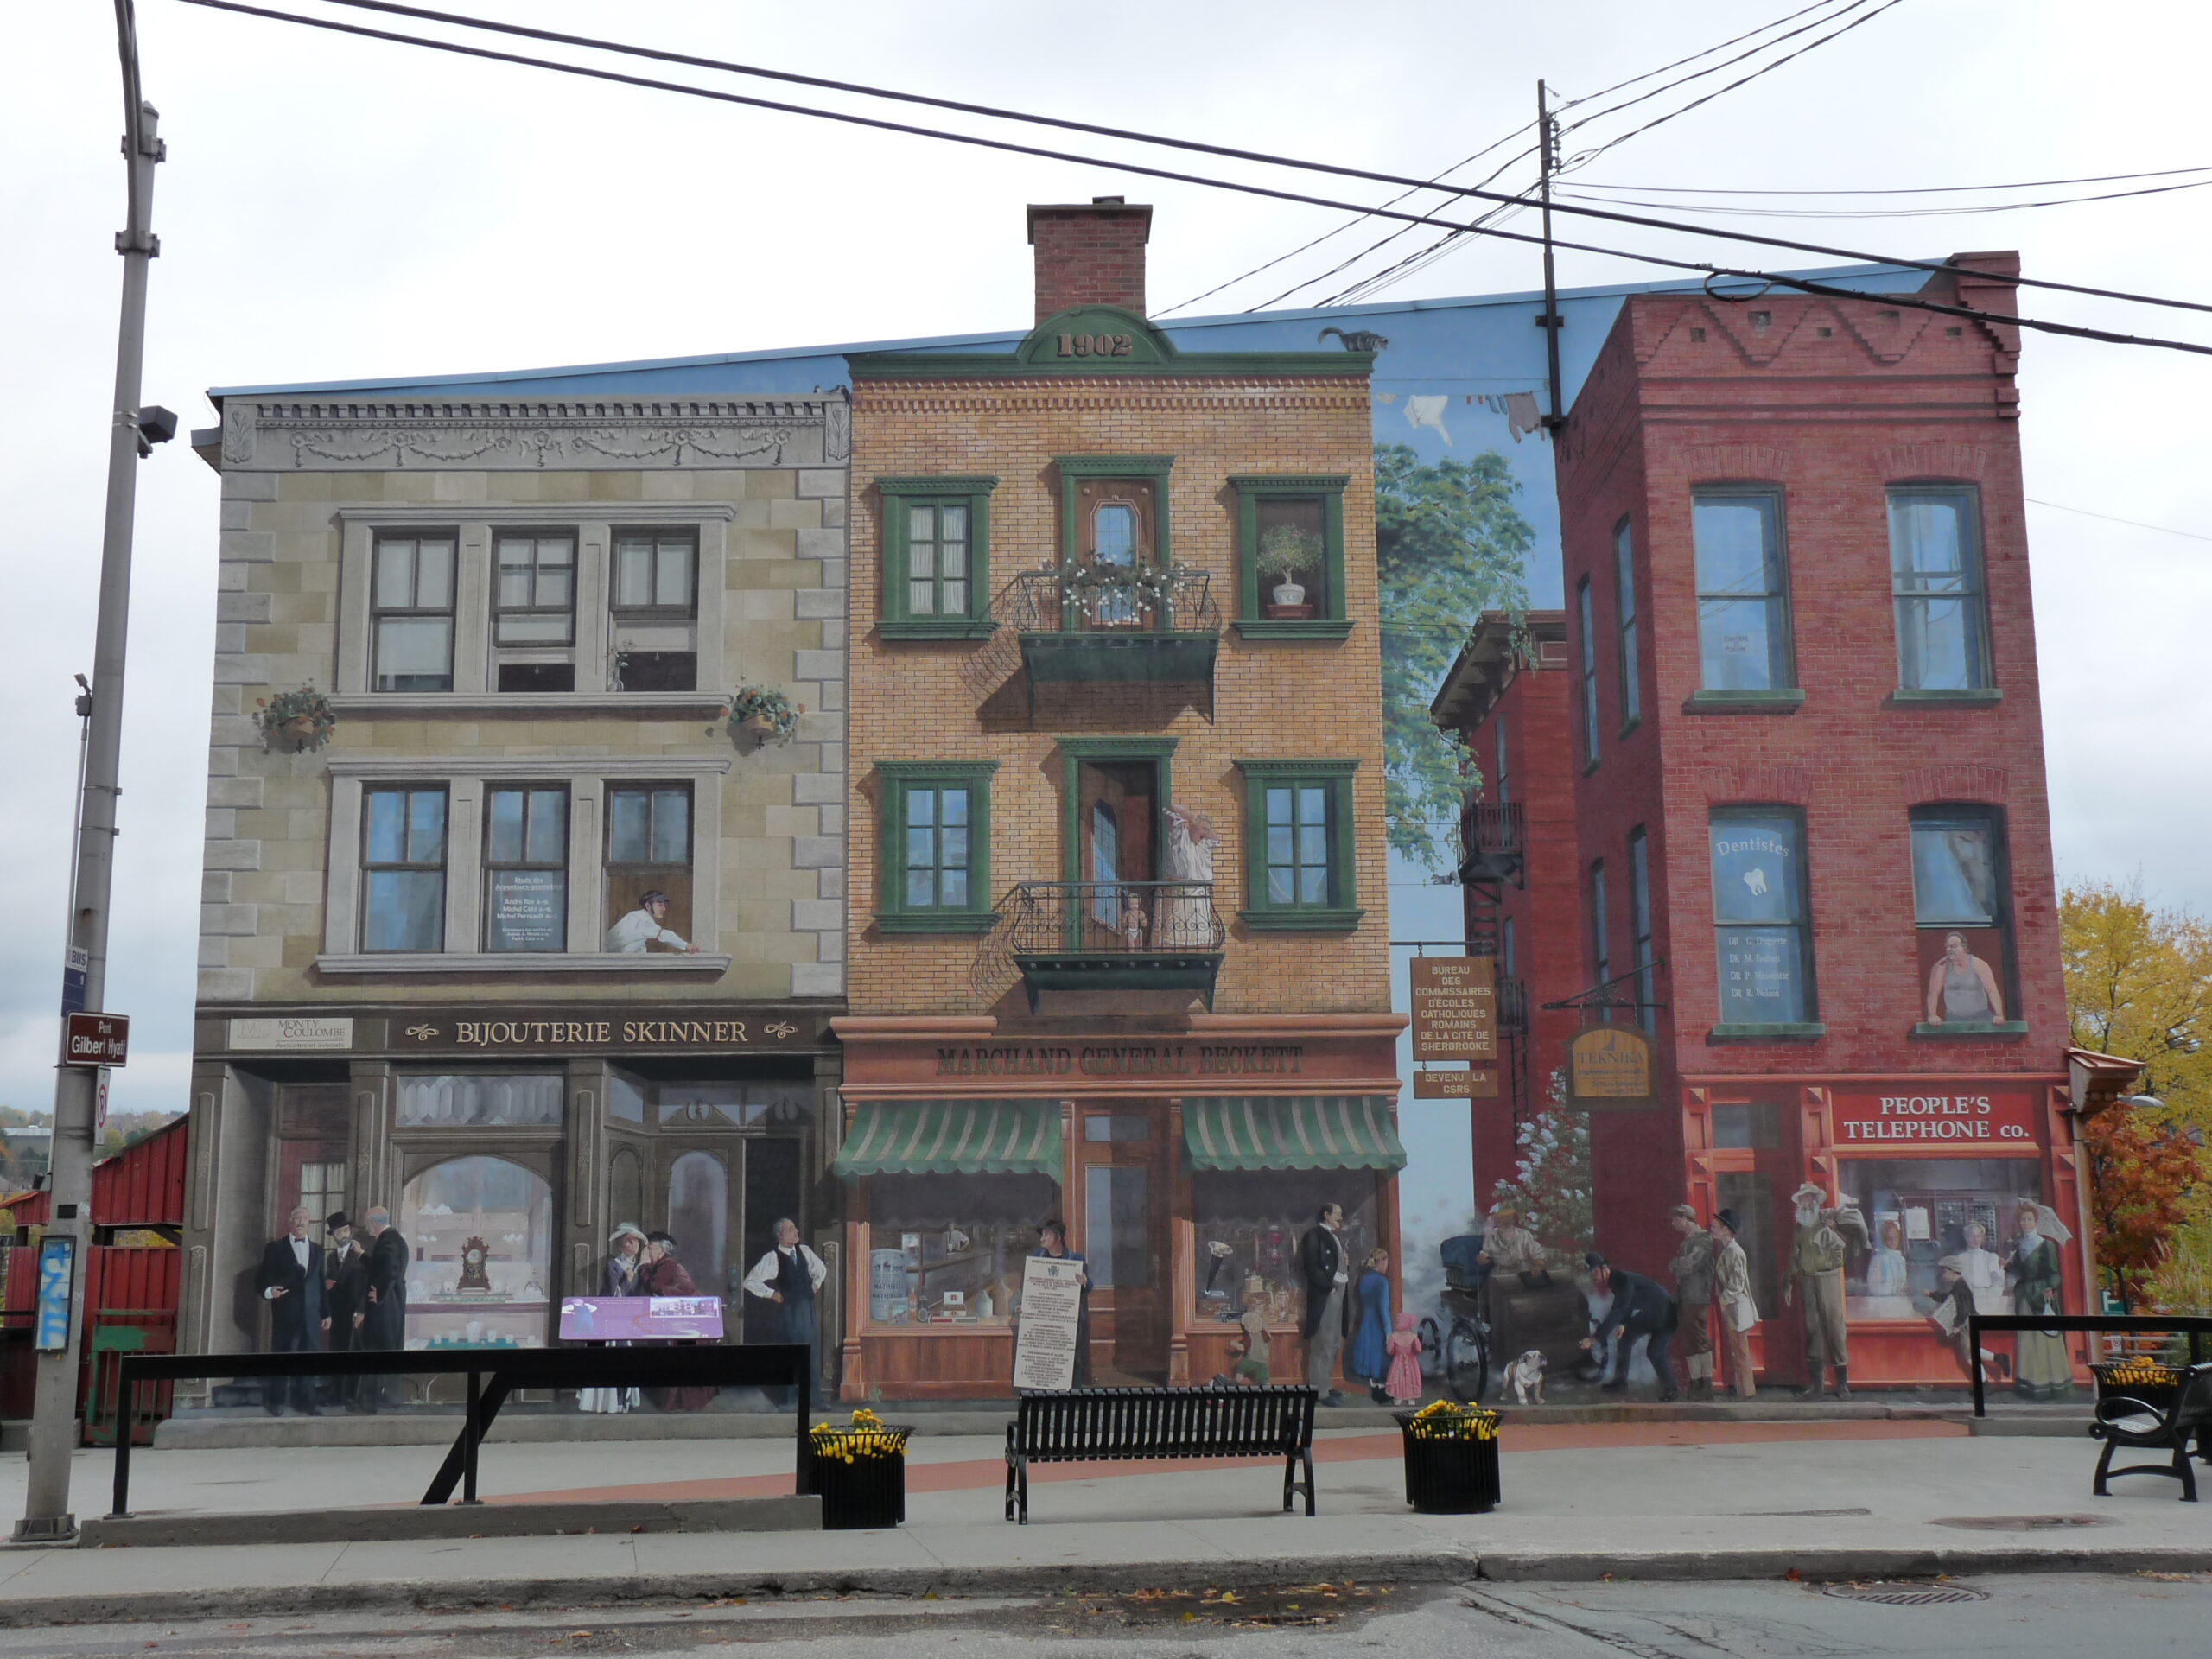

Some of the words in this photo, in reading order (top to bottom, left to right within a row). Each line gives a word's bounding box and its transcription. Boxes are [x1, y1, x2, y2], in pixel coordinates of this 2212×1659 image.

[1057, 334, 1132, 358] 1902
[1716, 836, 1790, 857] Dentistes
[71, 950, 86, 966] BUS
[1431, 966, 1470, 975] BUREAU
[1441, 976, 1461, 985] DES
[1415, 987, 1491, 996] COMMISSAIRES
[1421, 1009, 1486, 1019] CATHOLIQUES
[278, 1020, 319, 1029] MONTY
[1431, 1020, 1477, 1029] ROMAINS
[283, 1027, 346, 1038] COULOMBE
[455, 1021, 611, 1046] BIJOUTERIE
[622, 1020, 748, 1043] SKINNER
[1421, 1031, 1433, 1039] DE
[1435, 1031, 1449, 1039] LA
[1476, 1031, 1489, 1039] DE
[71, 1035, 105, 1055] Gilbert
[108, 1038, 125, 1058] Hyatt
[1421, 1041, 1490, 1051] SHERBROOKE
[936, 1047, 1072, 1077] MARCHAND
[1198, 1046, 1304, 1075] BECKETT
[1578, 1052, 1645, 1065] TEKNIKA
[1425, 1073, 1465, 1082] DEVENU
[1472, 1072, 1486, 1081] LA
[1443, 1084, 1471, 1094] CSRS
[1879, 1096, 1991, 1116] PEOPLE'S
[1843, 1120, 1991, 1139] TELEPHONE
